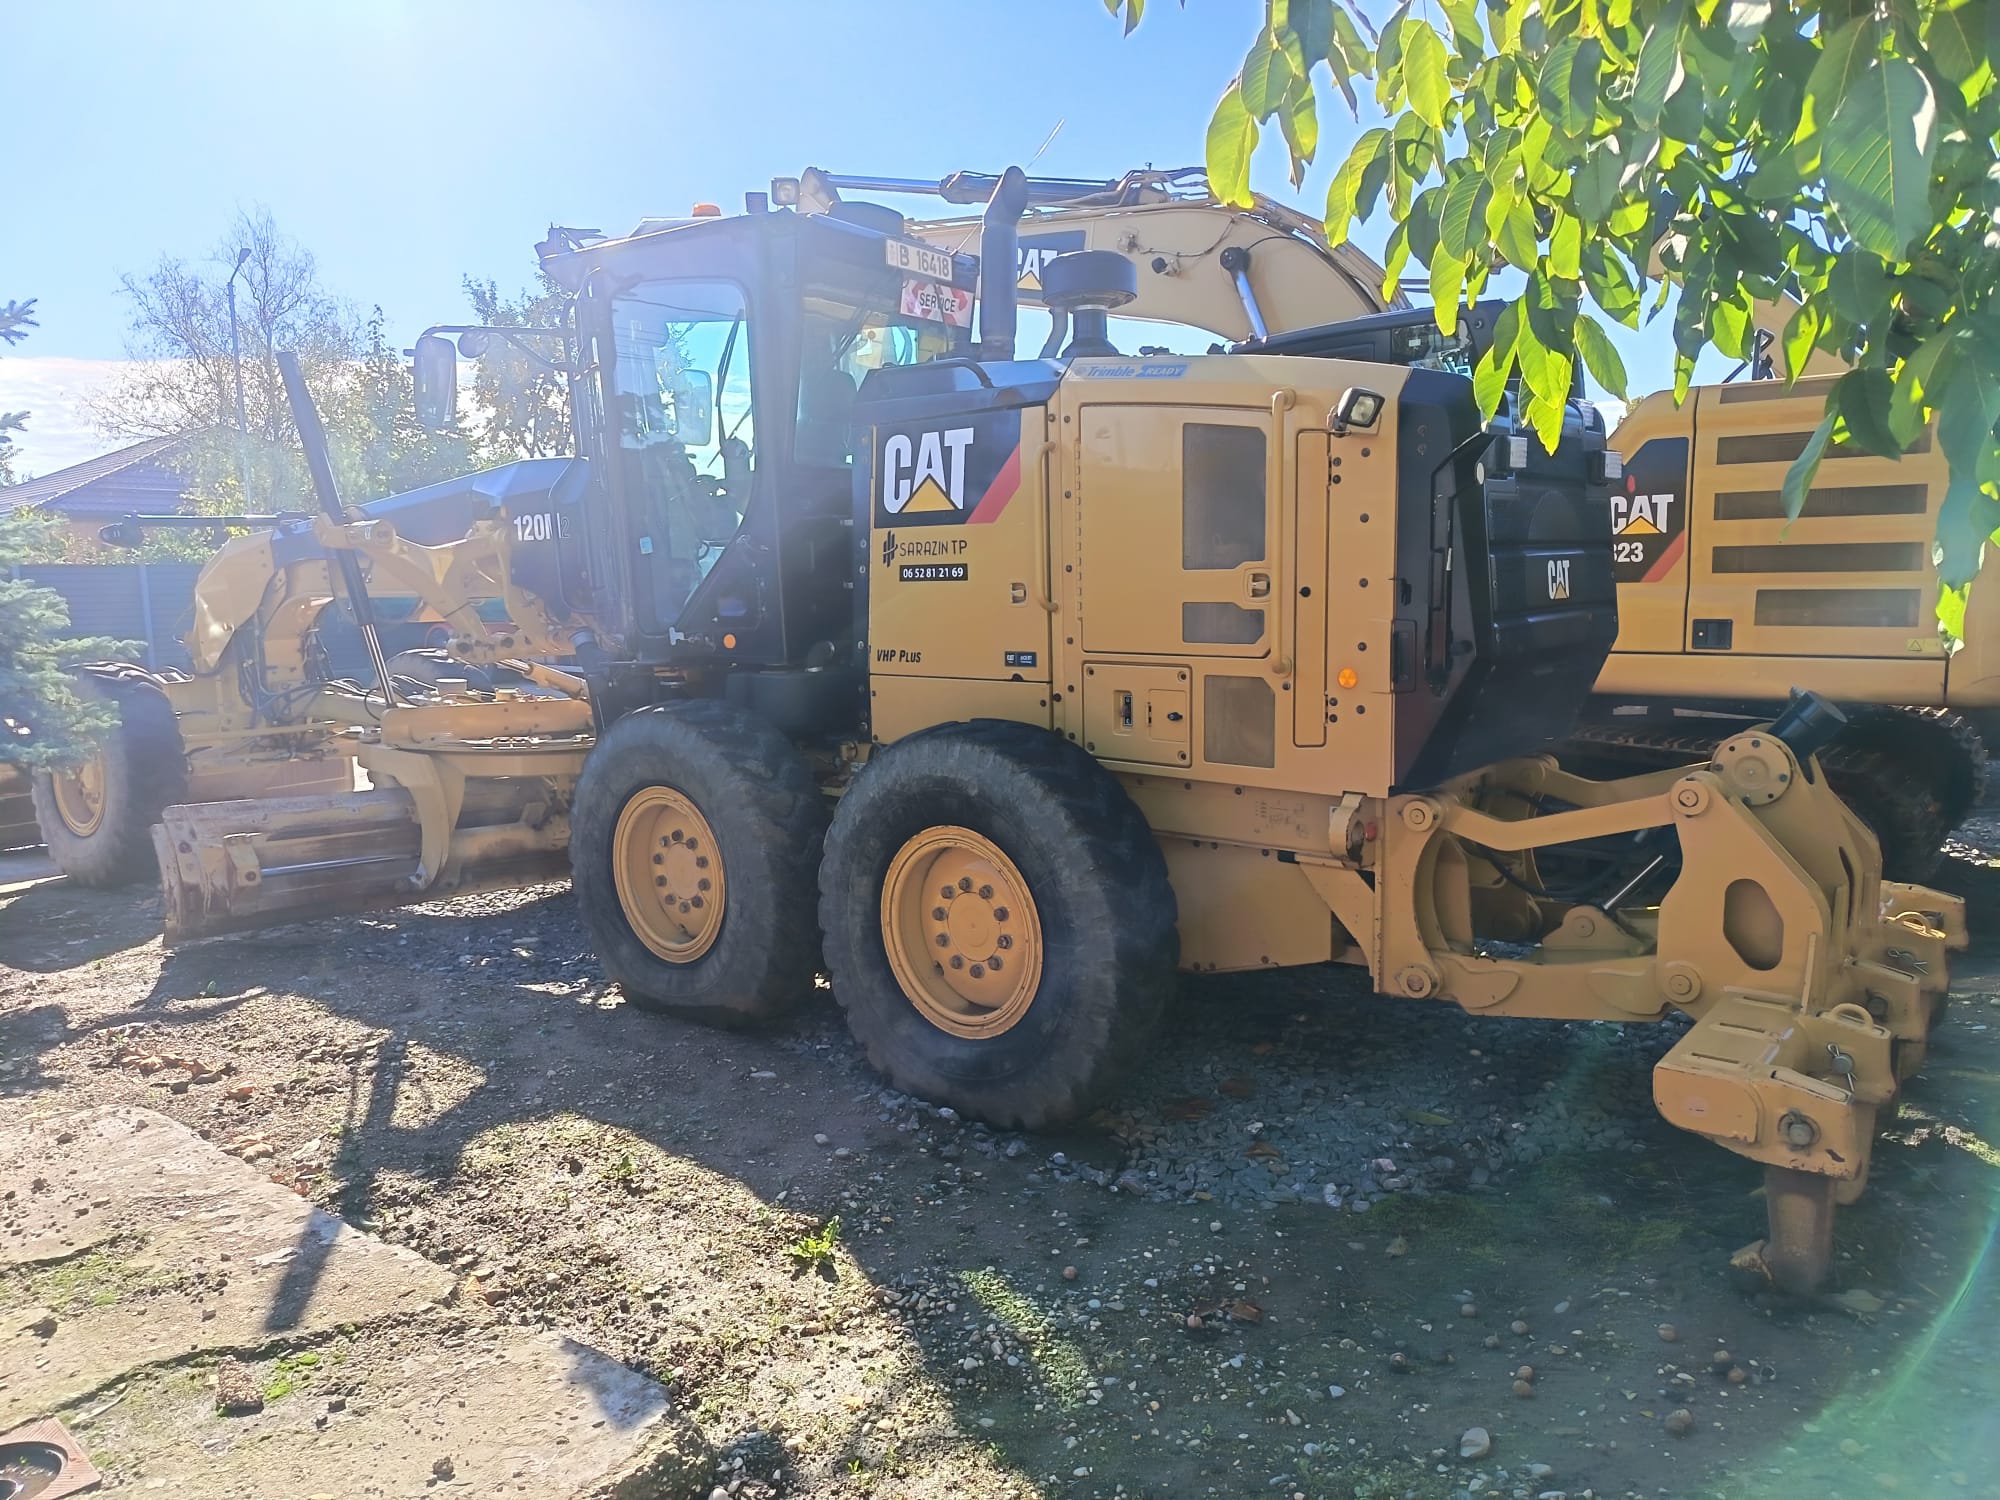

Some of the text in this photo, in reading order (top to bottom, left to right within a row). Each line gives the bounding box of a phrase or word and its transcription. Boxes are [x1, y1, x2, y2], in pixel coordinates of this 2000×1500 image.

[899, 244, 950, 278] B 16418
[1087, 366, 1182, 377] Trimble READY
[884, 427, 975, 514] CAT
[1610, 494, 1674, 535] CAT
[899, 539, 968, 557] SARAZIN TP
[1613, 542, 1644, 563] 23
[903, 567, 964, 578] 06 52 81 21 69
[1547, 559, 1570, 600] CAT
[876, 649, 896, 662] VHP
